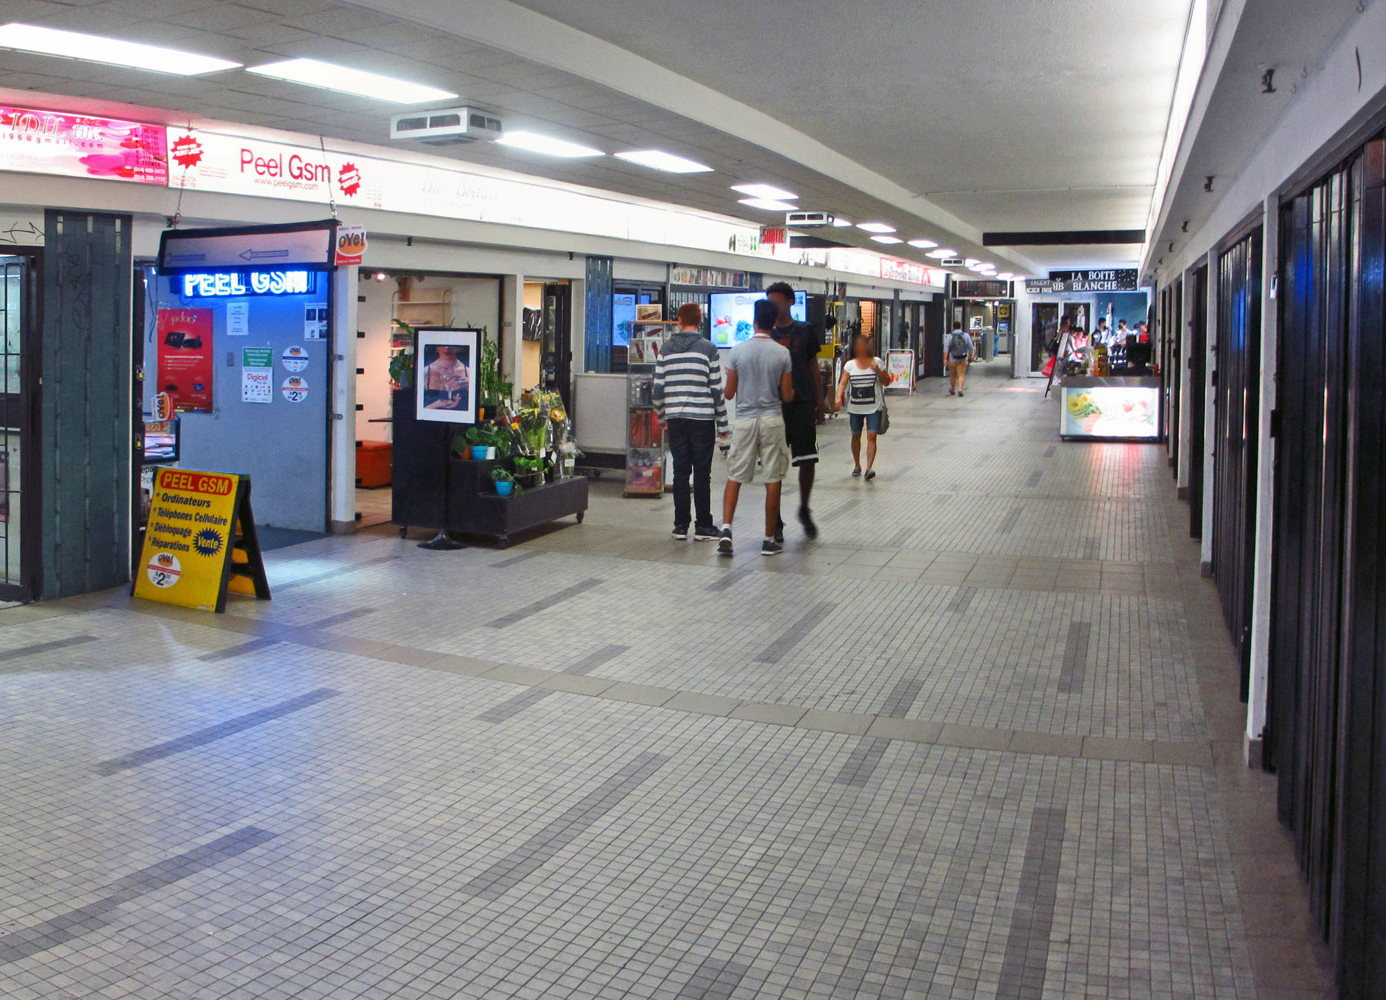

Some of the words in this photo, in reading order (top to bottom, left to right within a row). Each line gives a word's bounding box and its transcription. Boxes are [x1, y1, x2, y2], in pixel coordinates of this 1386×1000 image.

[240, 147, 283, 178] Peel
[288, 153, 331, 183] Gsm
[253, 177, 319, 190] www.peelgsm.com
[184, 271, 246, 296] PEEL
[1071, 272, 1083, 281] LA
[1088, 270, 1116, 281] BOITE
[1072, 281, 1118, 291] BLANCHE
[163, 472, 195, 491] PEEL
[198, 477, 230, 494] GSM
[161, 492, 212, 508] Ordinateurs
[157, 507, 193, 521] Téléphones
[194, 512, 228, 526] Cellulaire
[154, 522, 193, 539] Débloquage
[151, 536, 191, 552] Réparations
[196, 535, 220, 549] Vente
